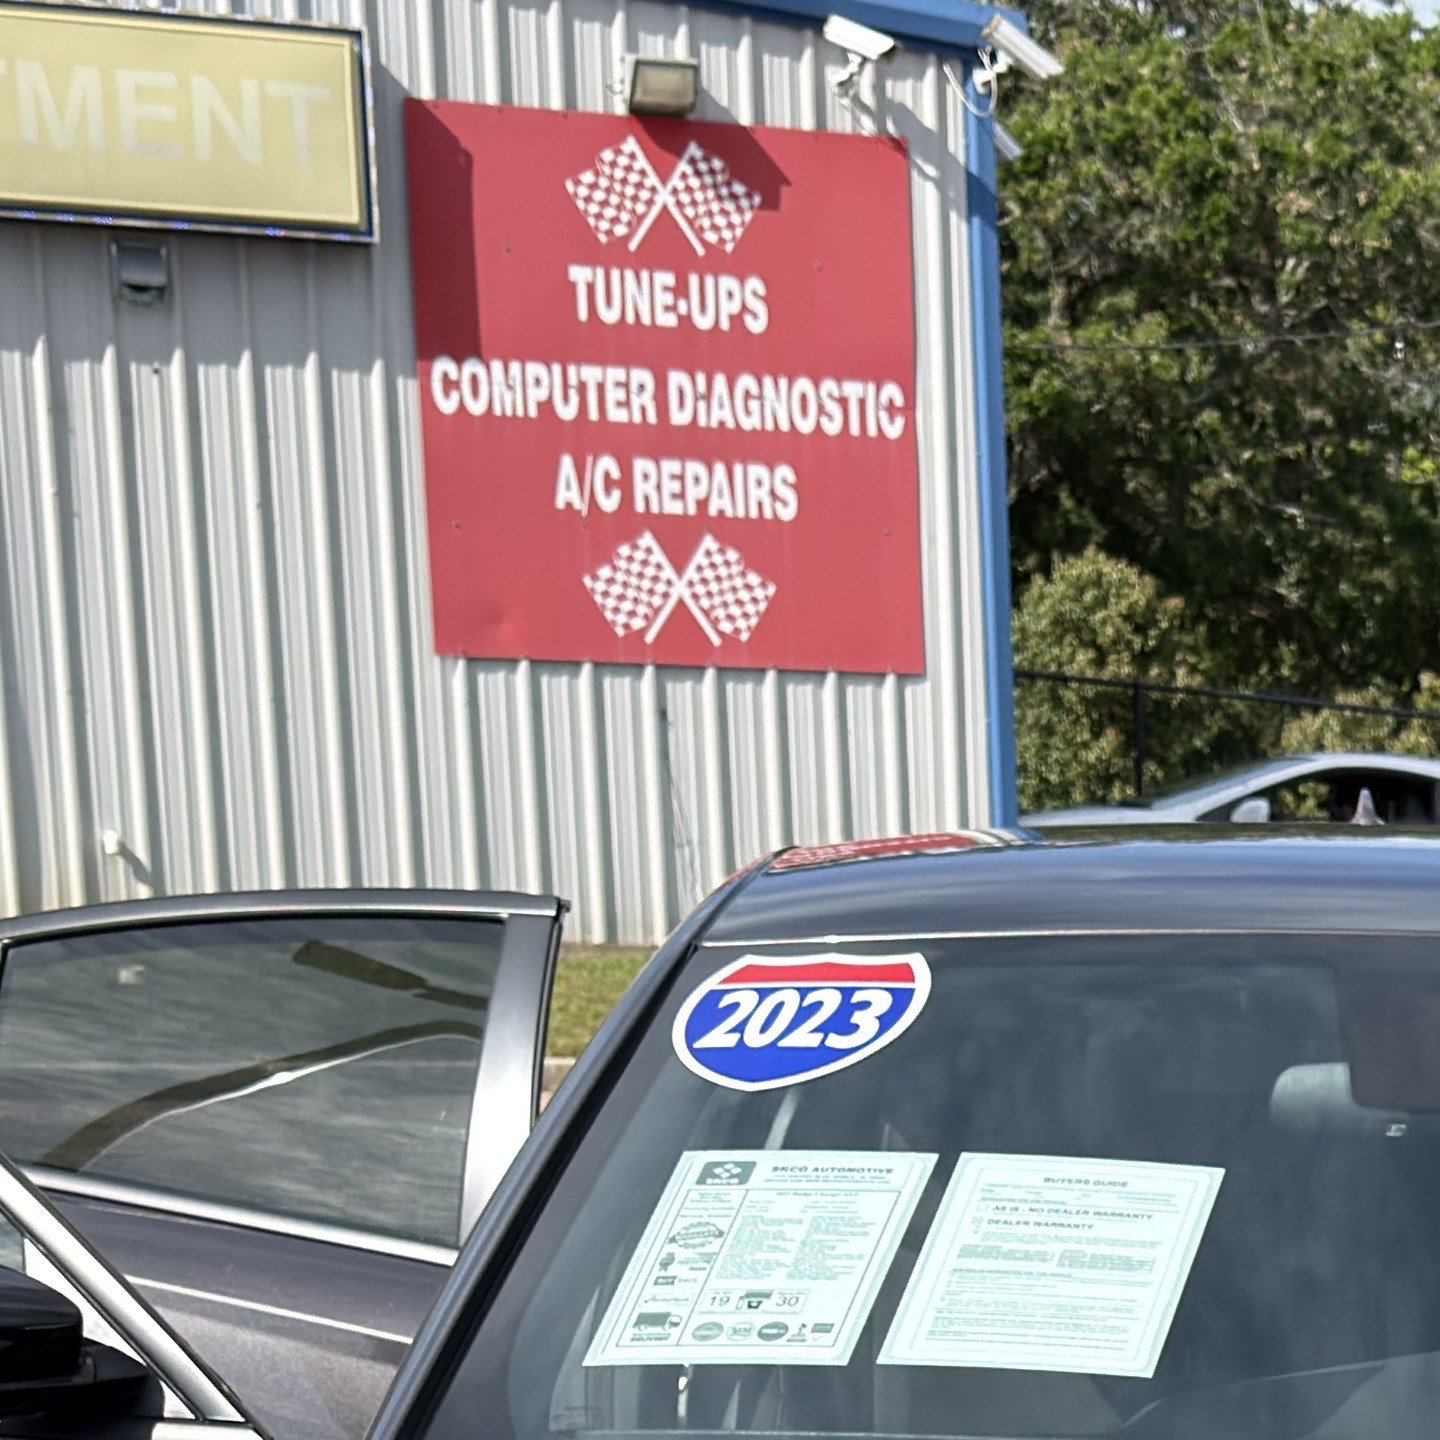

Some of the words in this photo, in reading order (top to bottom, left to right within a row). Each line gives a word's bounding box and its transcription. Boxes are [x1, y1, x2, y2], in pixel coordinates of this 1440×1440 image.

[567, 263, 769, 335] TUNE-UPS
[430, 355, 658, 425] COMPUTER
[666, 367, 907, 441] DIAGNOSTIC
[554, 452, 622, 518] A/C
[631, 455, 800, 522] REPAIRS
[692, 988, 894, 1050] 2023
[709, 1296, 731, 1307] 19
[775, 1295, 800, 1307] 30
